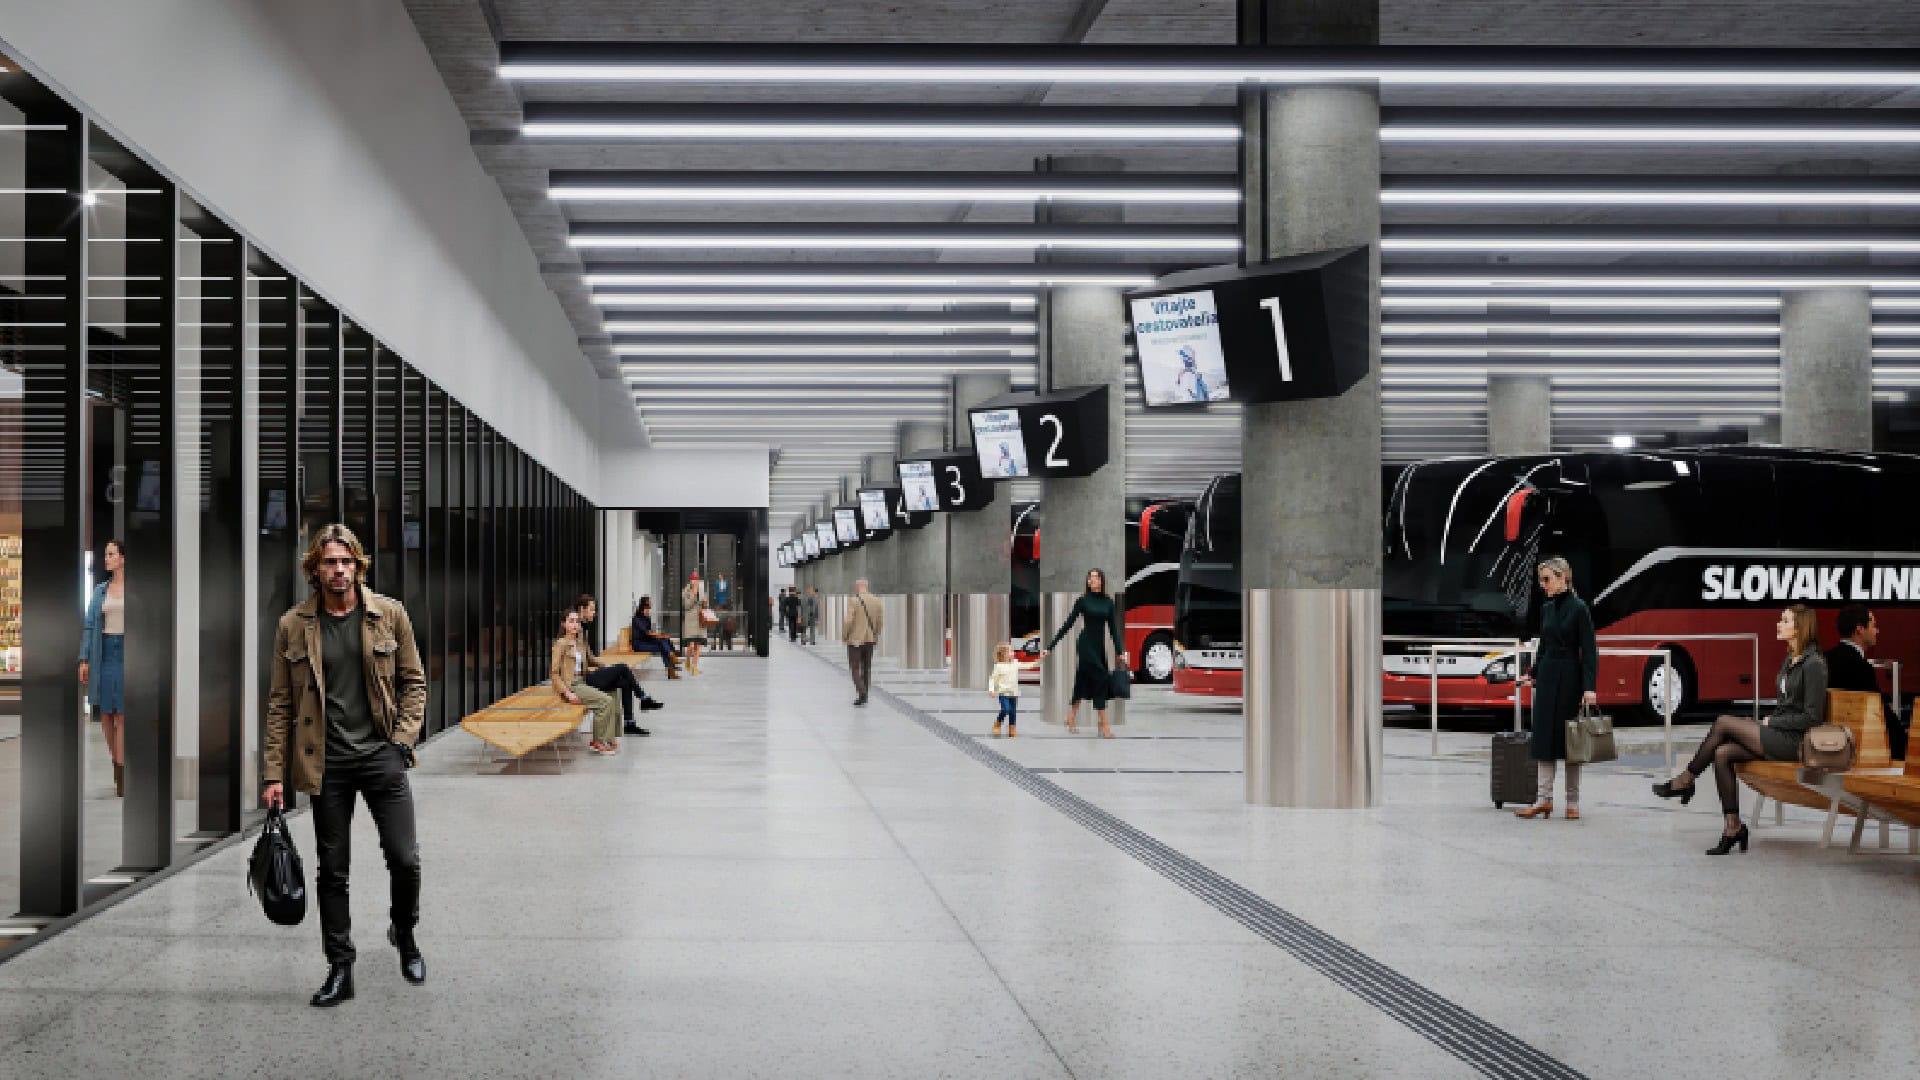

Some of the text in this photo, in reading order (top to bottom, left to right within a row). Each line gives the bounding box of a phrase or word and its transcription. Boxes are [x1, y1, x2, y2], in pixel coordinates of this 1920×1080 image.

[1260, 297, 1293, 382] 1
[1040, 414, 1070, 468] 2
[946, 466, 966, 506] 3
[1702, 565, 1846, 602] SLOVAK
